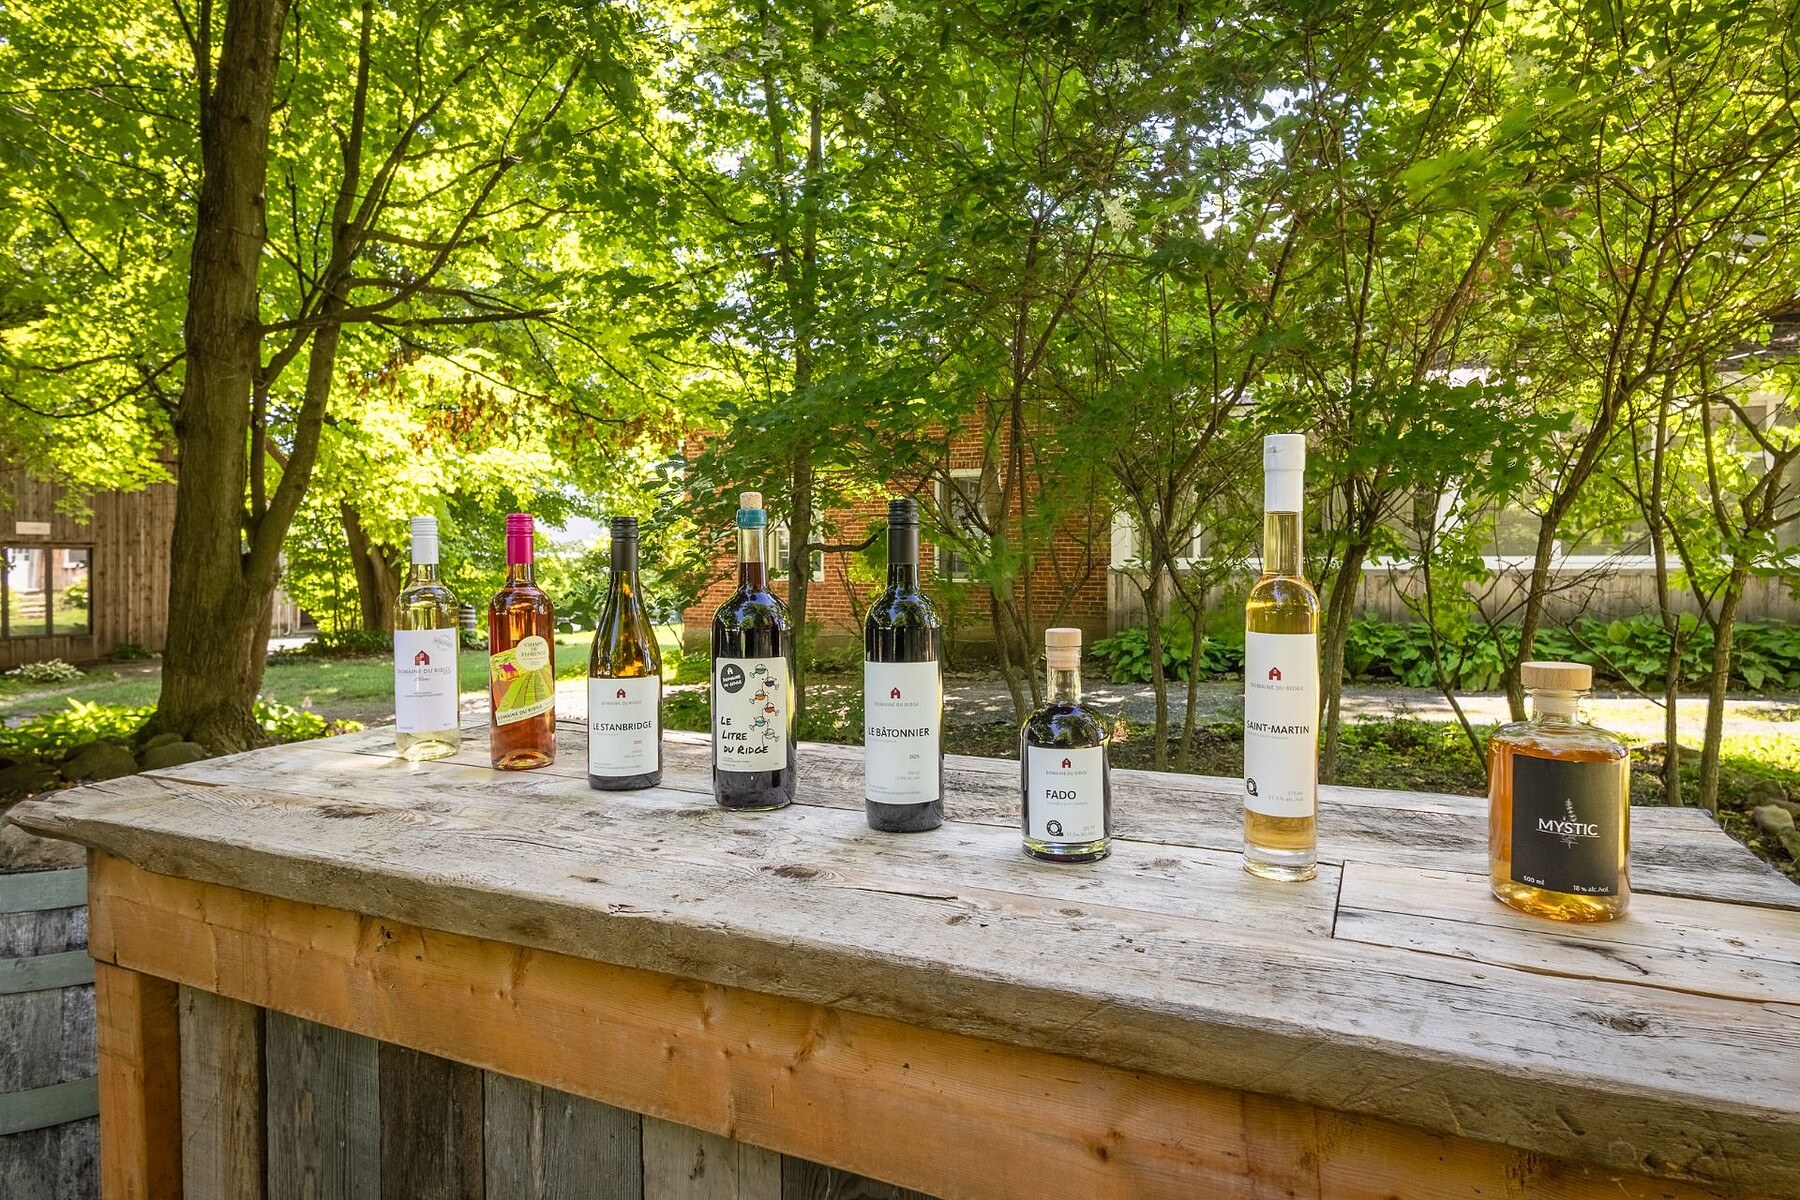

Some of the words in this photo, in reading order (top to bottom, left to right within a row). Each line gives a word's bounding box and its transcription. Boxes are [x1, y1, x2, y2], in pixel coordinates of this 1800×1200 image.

[593, 722, 600, 731] LE
[600, 720, 653, 731] STANBRIDGE
[720, 716, 732, 726] LE
[868, 727, 875, 736] LE
[876, 726, 930, 738] BÂTONNIER
[1246, 720, 1310, 735] SAINT-MARTIN
[722, 730, 748, 741] LITRE
[723, 745, 734, 753] DU
[737, 745, 769, 755] RIDGE
[1045, 789, 1077, 800] FADO
[1538, 817, 1599, 836] MYSTIC
[1523, 875, 1535, 883] 500
